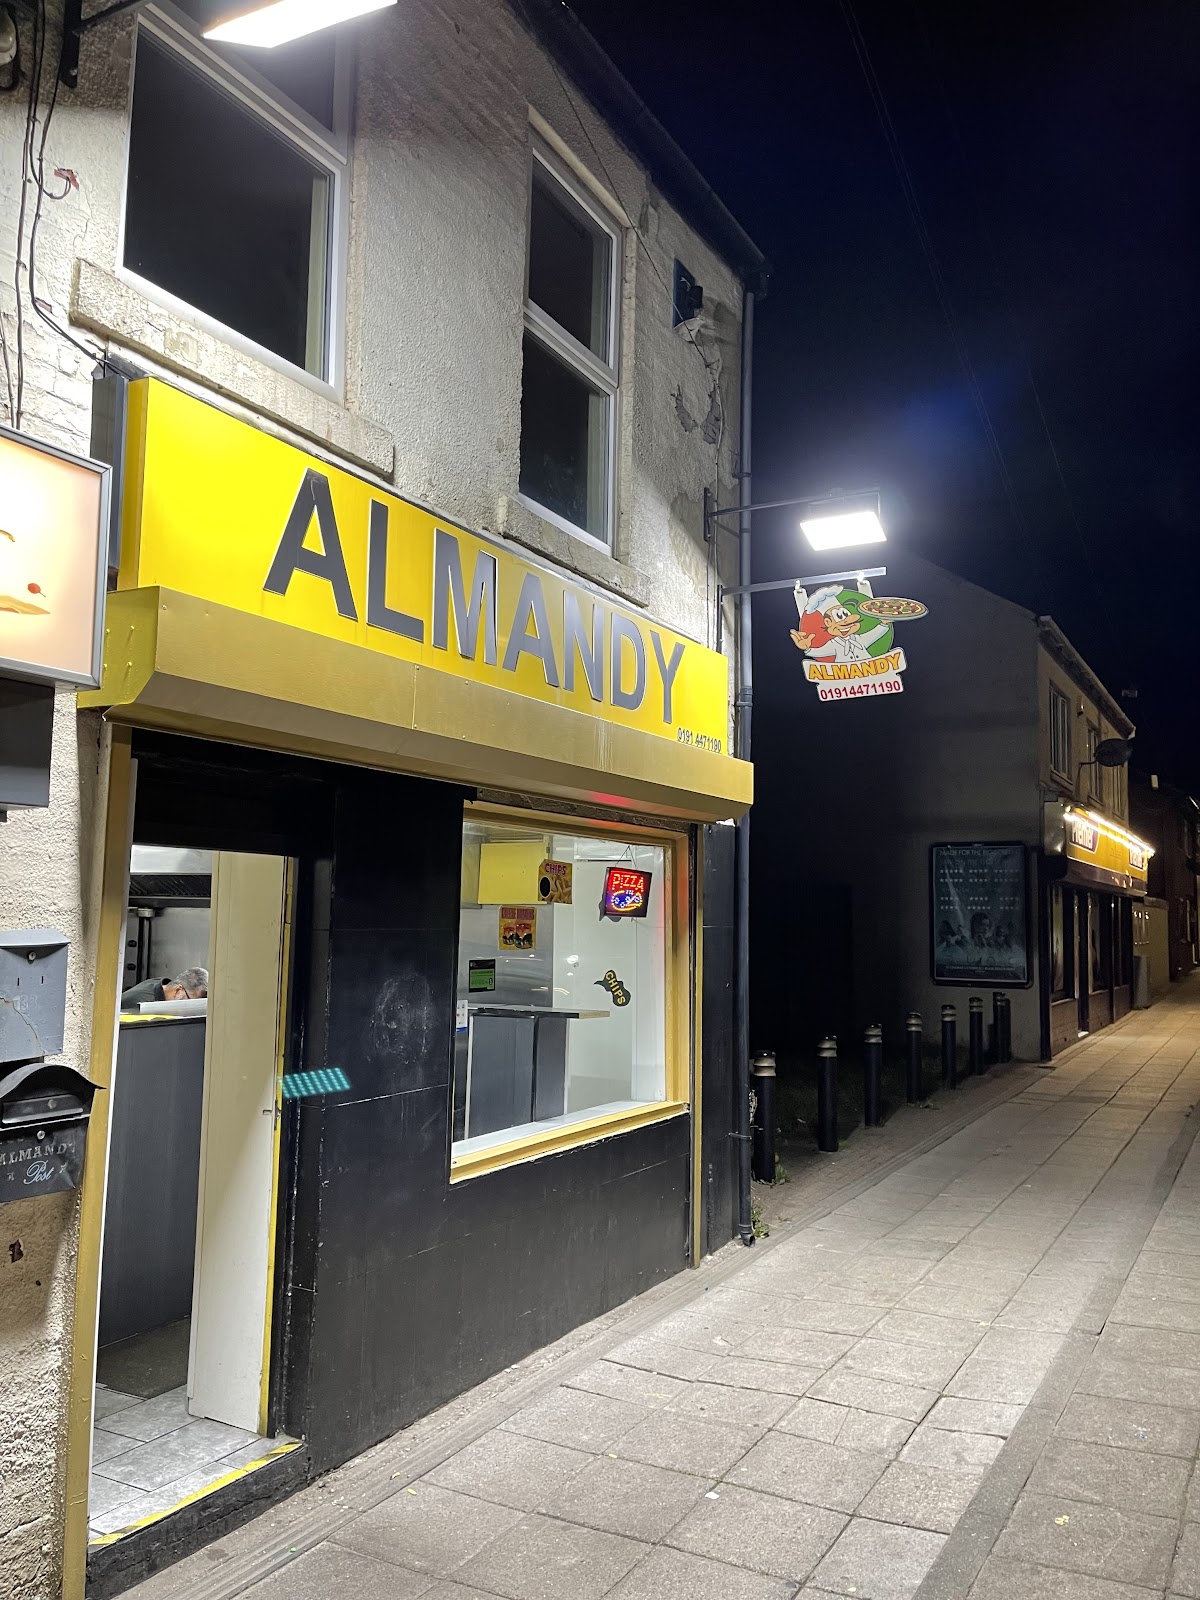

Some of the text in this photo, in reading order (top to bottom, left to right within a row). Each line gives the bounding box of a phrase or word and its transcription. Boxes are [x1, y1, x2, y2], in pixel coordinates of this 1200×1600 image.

[263, 467, 685, 724] ALMANDY
[808, 652, 902, 681] ALMANDY
[819, 680, 902, 701] 01914471190
[677, 728, 722, 753] 0191 4471190
[544, 863, 566, 876] CHIPS
[612, 873, 645, 892] PIZZA
[606, 972, 626, 1005] CHIPS
[23, 1159, 55, 1185] Post
